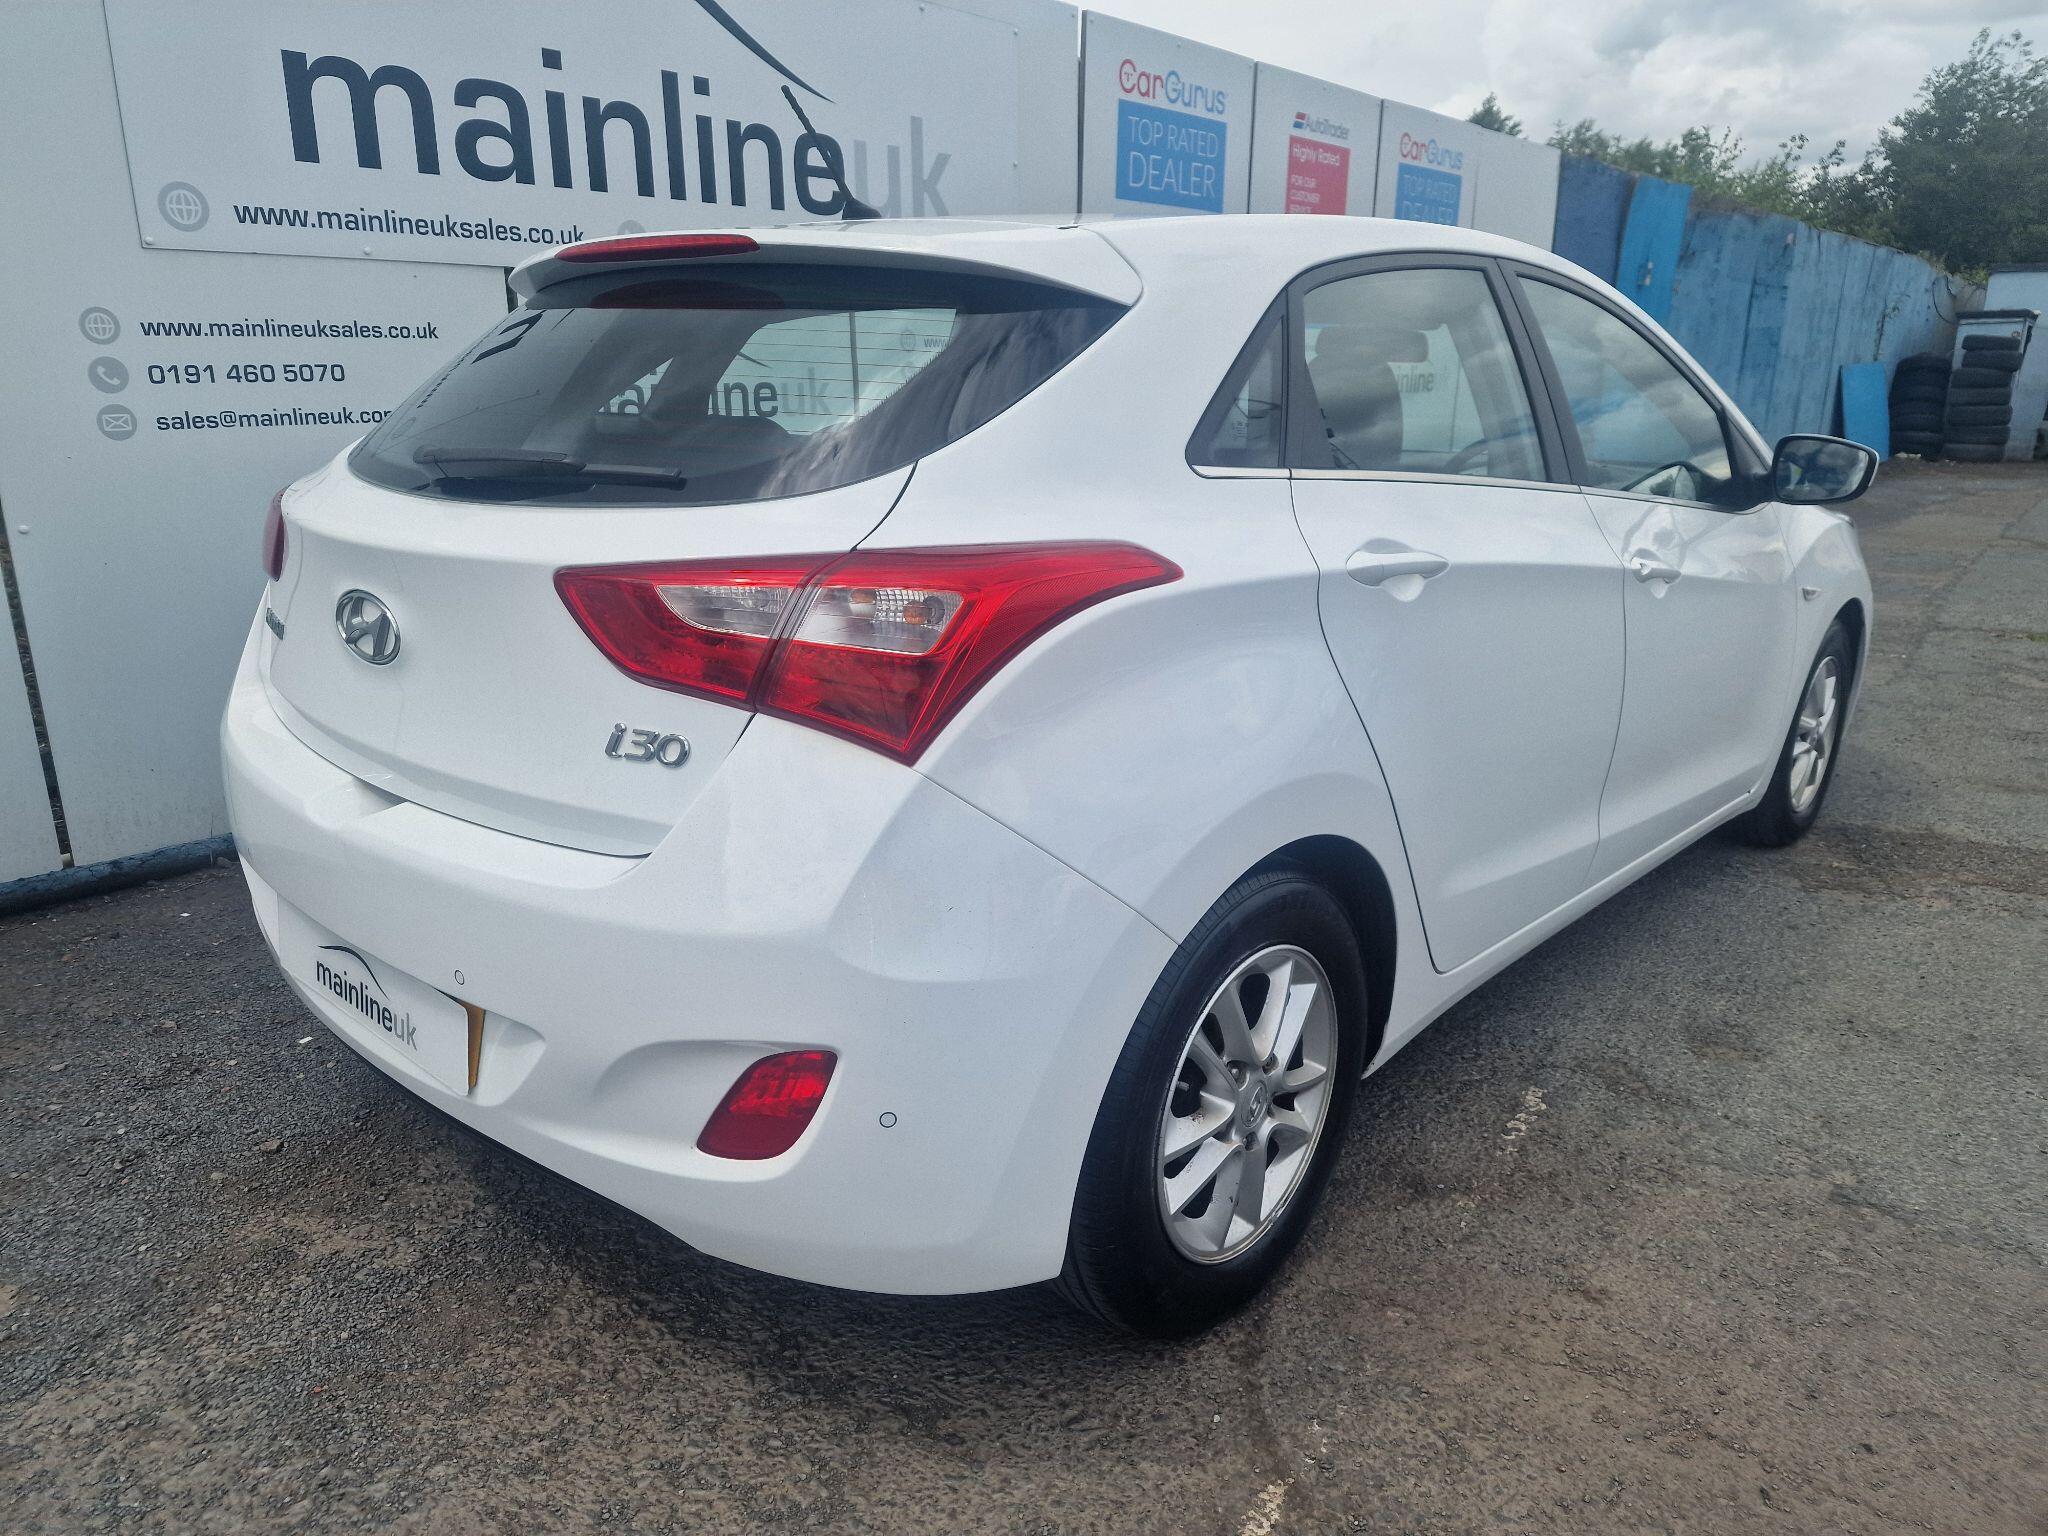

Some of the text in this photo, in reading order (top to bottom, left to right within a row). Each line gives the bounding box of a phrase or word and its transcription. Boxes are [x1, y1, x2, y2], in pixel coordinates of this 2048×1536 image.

[1119, 58, 1226, 116] CarGurus
[281, 46, 952, 217] mainlineuk
[1128, 116, 1219, 158] TOP RATED
[1129, 151, 1216, 198] DEALER
[233, 204, 585, 245] www.mainlineuksales.co.uk
[140, 318, 439, 340] www.mainlineuksales.co.uk
[147, 363, 346, 385] 0191 460 5070
[605, 722, 692, 769] i30
[316, 960, 418, 1052] mainlineuk
